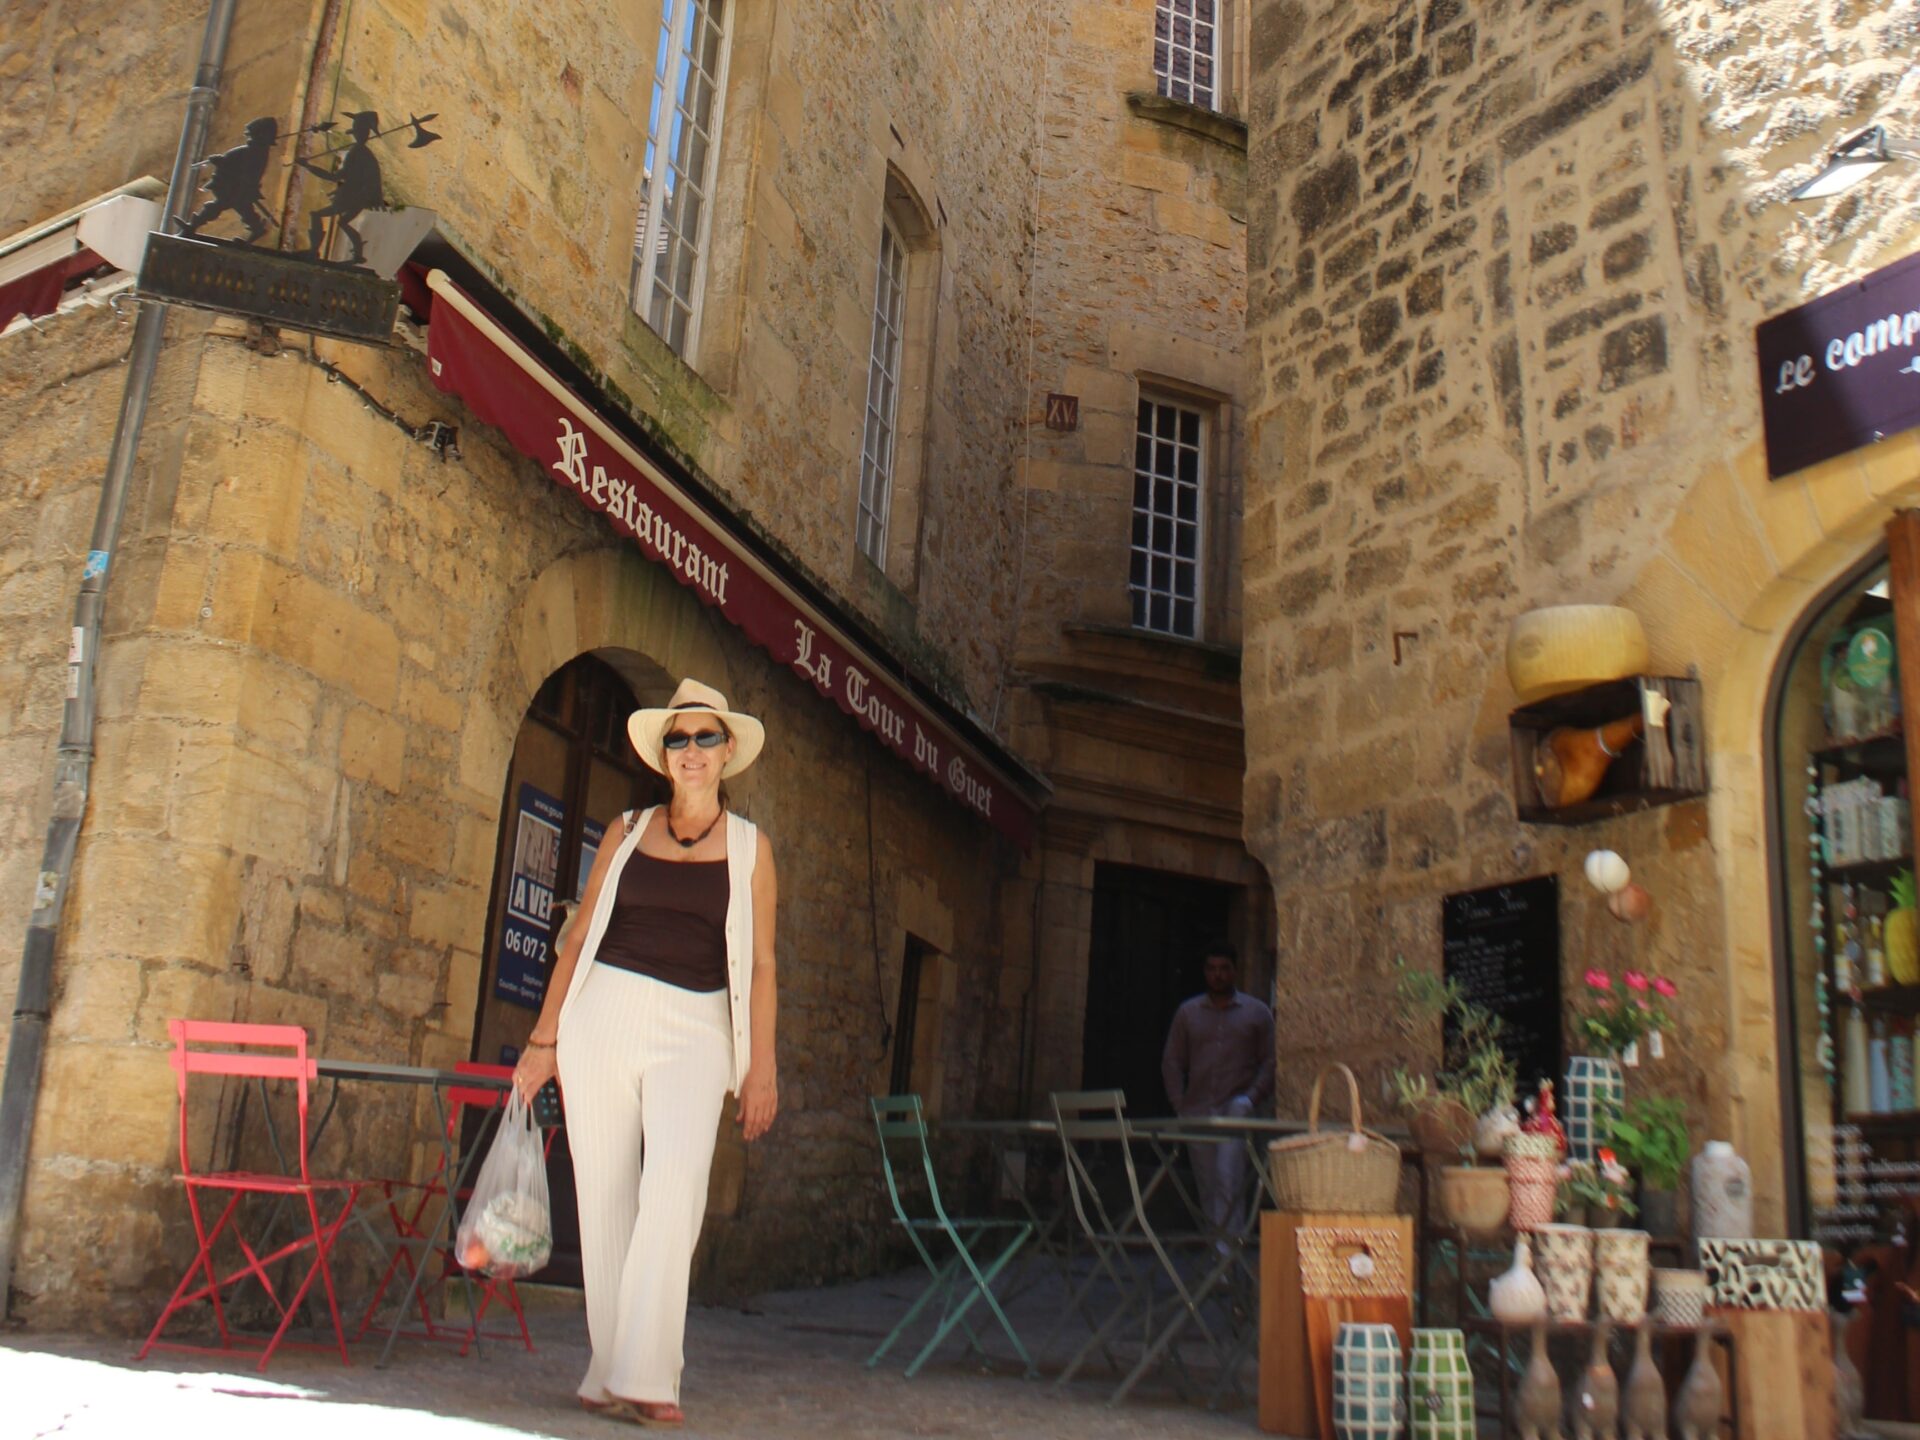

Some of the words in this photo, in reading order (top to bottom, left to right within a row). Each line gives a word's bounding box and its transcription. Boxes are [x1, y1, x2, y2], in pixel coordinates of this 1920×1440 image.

[552, 417, 729, 605] Restaurant
[794, 619, 832, 688] La
[845, 665, 905, 745] Tour
[914, 722, 939, 773] du
[948, 756, 992, 827] Guet
[505, 928, 521, 953] 06
[523, 935, 538, 959] 07
[539, 941, 547, 963] 2
[513, 878, 526, 910] A
